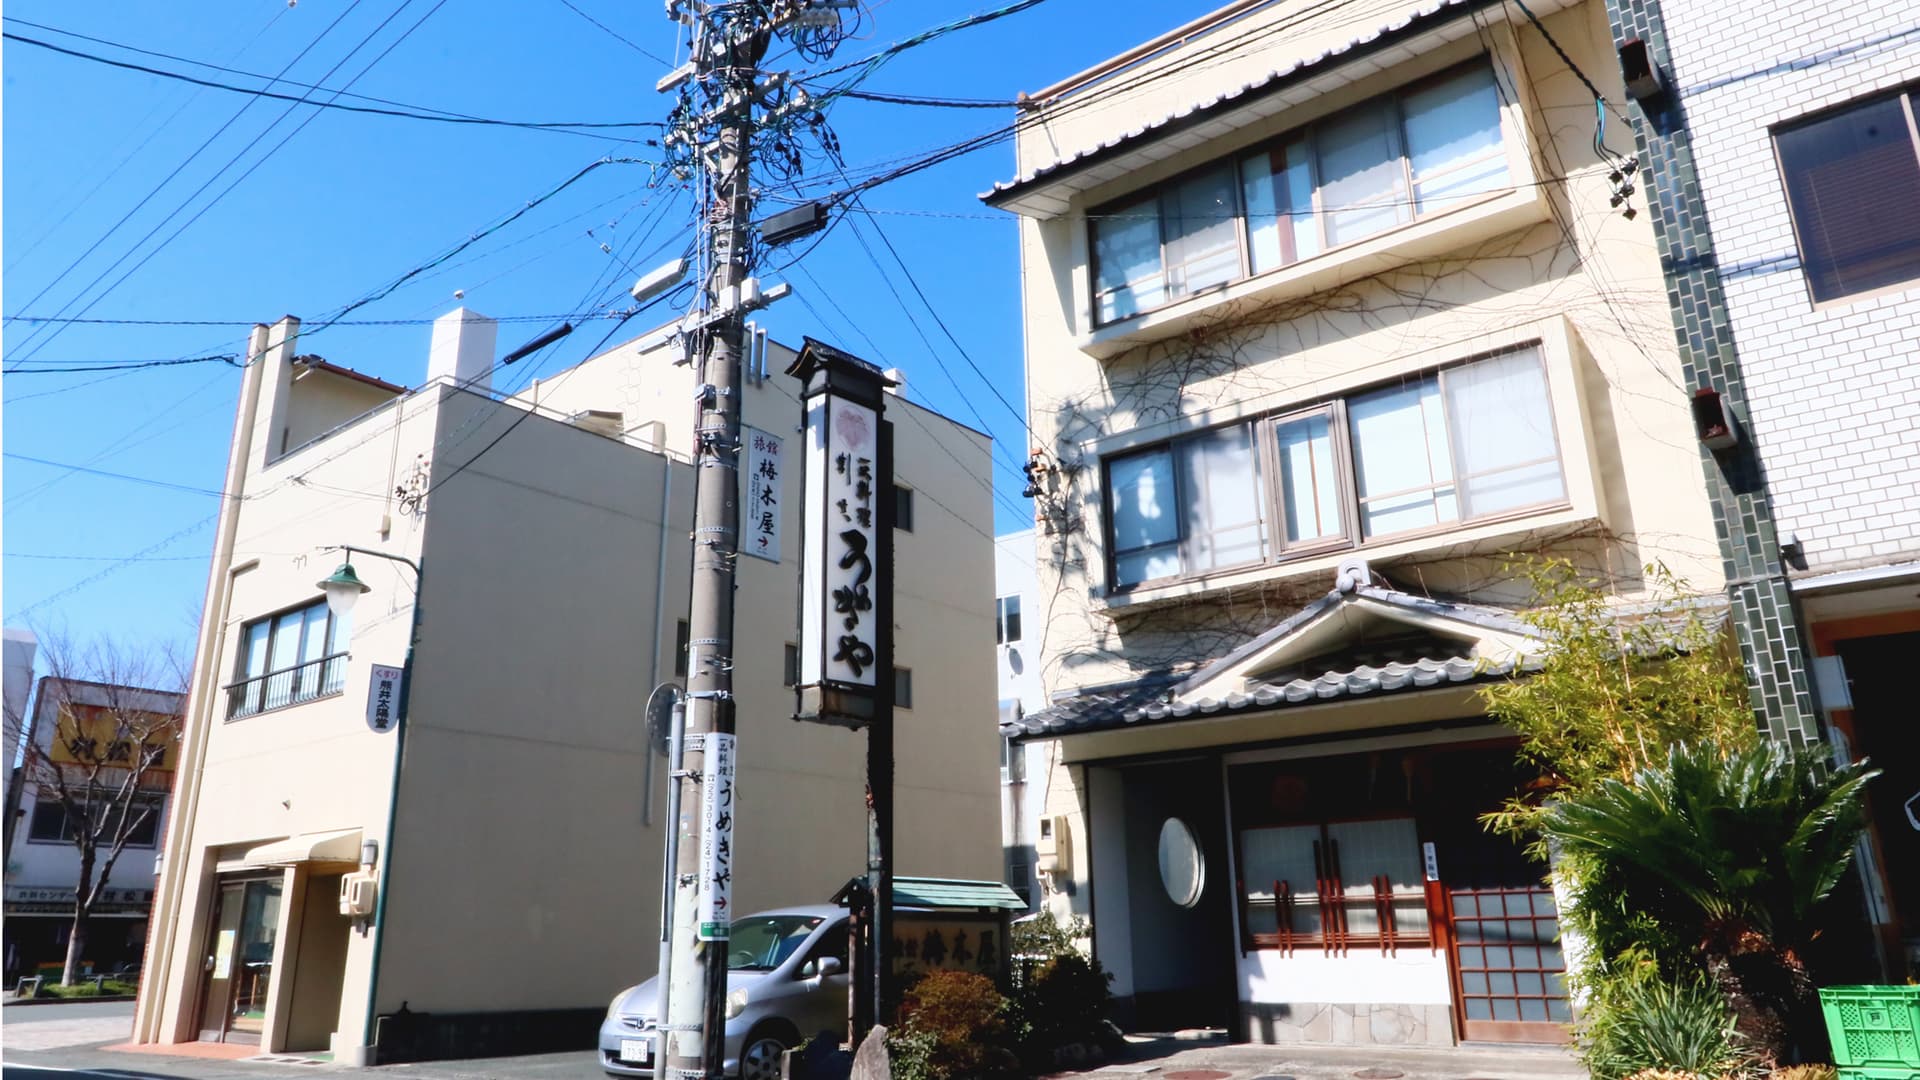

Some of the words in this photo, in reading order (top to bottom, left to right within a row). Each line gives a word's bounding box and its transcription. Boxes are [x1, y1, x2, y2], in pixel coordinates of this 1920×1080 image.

[754, 435, 779, 456] 旅館
[758, 458, 778, 536] 梅木屋
[376, 669, 398, 680] くすり
[718, 738, 728, 776] 一品料理
[713, 780, 732, 892] うめきや
